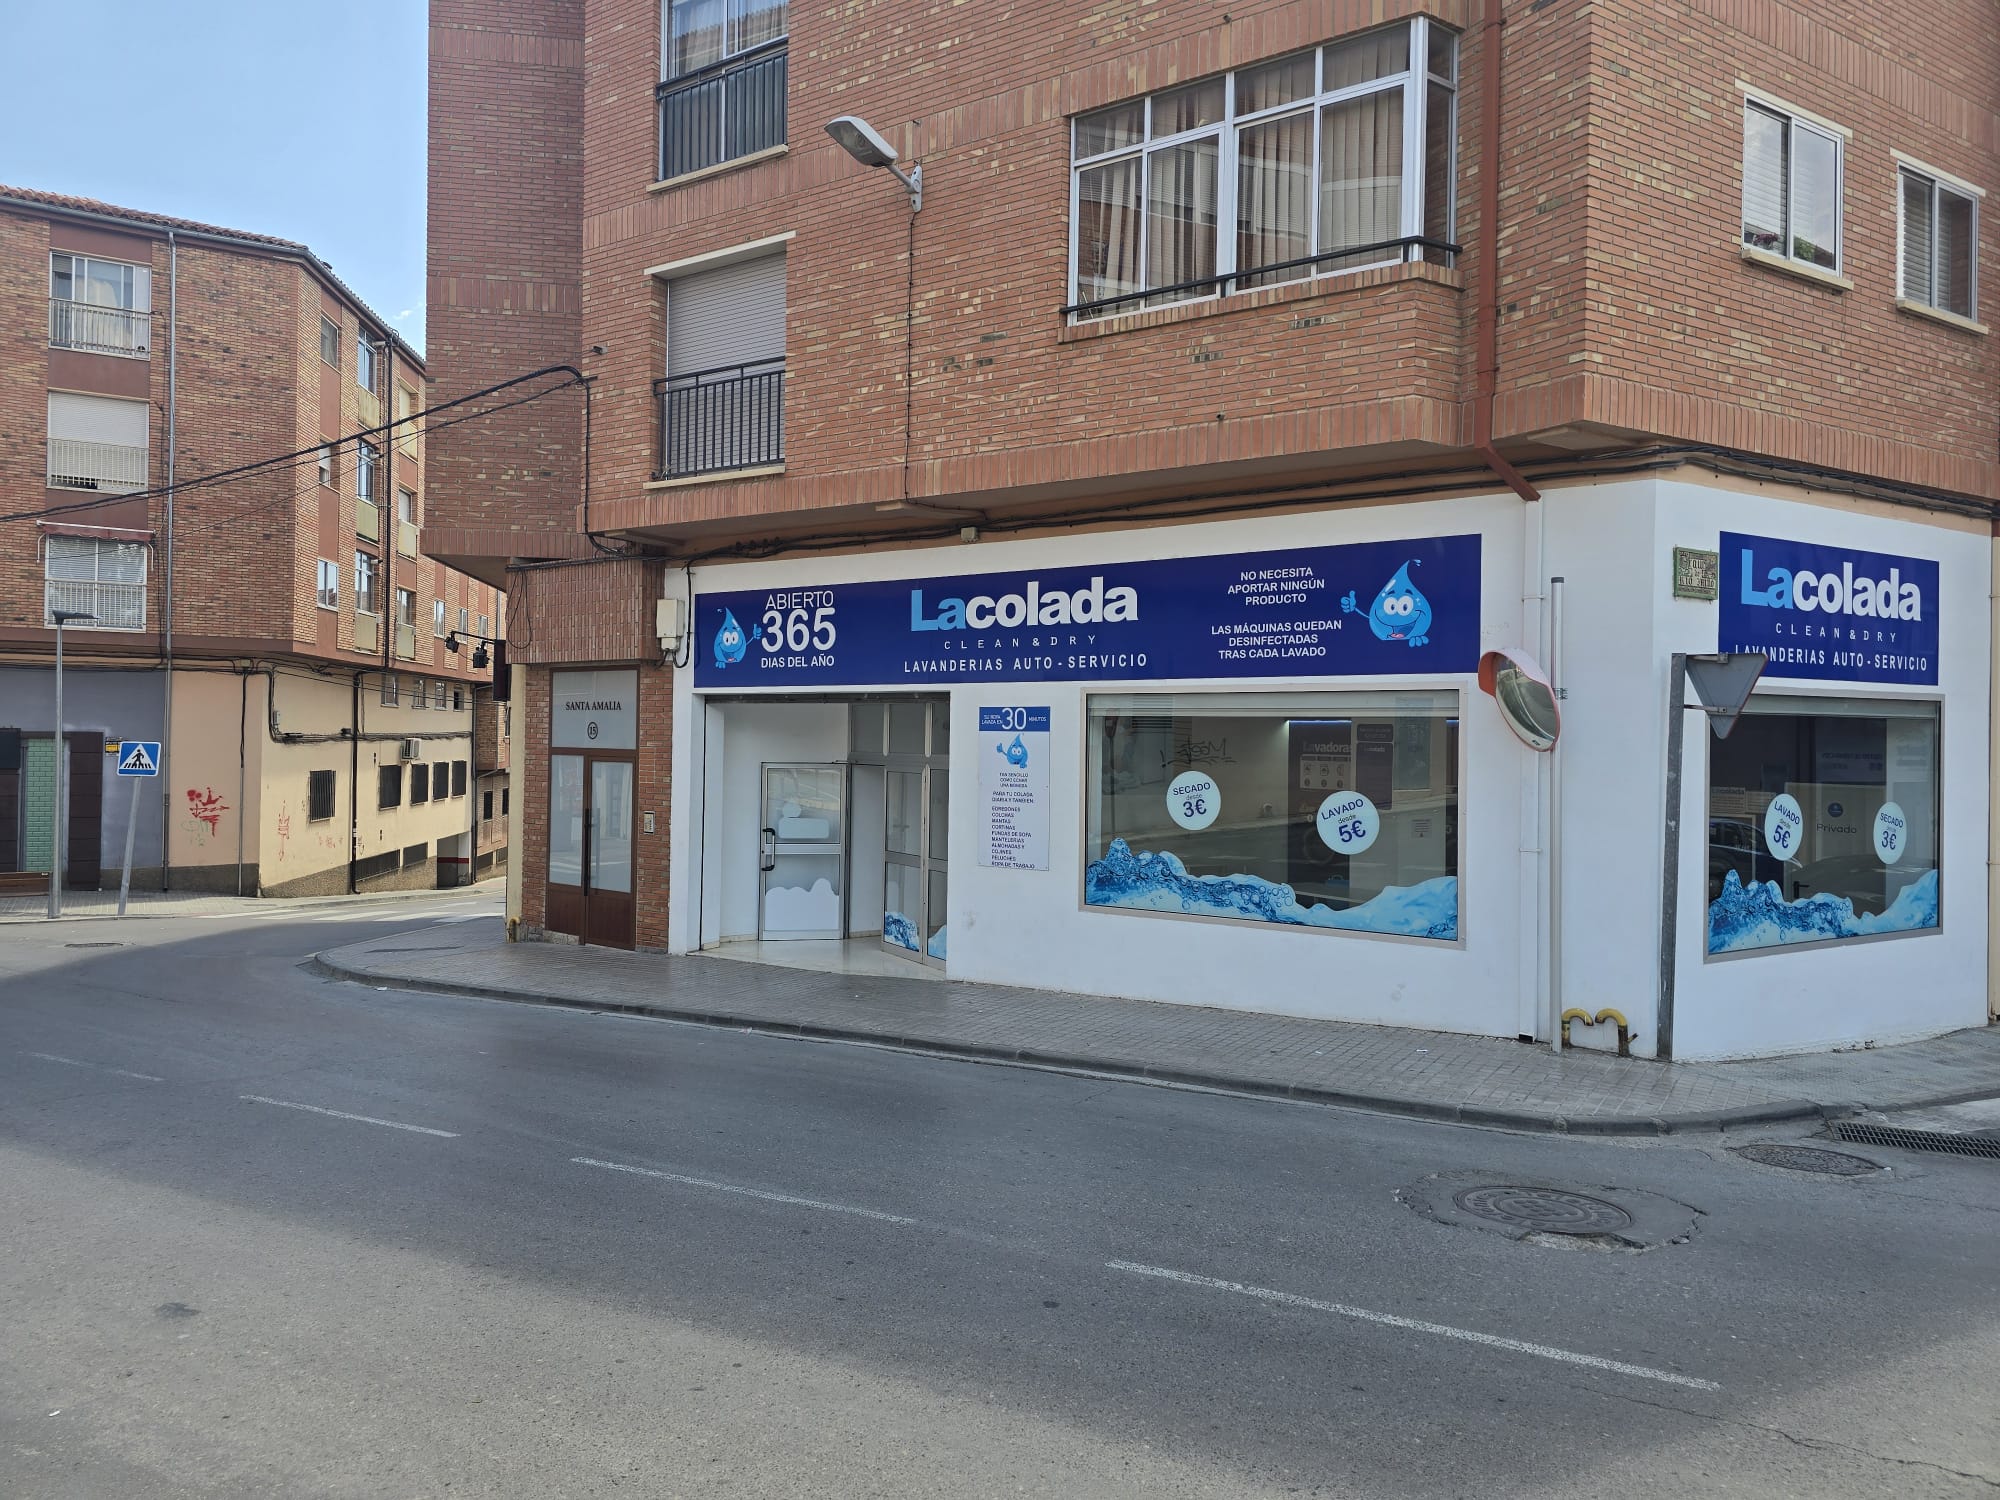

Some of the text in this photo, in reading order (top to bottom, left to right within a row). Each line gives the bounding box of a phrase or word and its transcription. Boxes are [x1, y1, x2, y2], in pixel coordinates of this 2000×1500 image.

[1240, 567, 1313, 581] NO NECESITA
[1228, 578, 1325, 594] APORTAR NINGÚN
[1741, 549, 1921, 621] Lacolada
[765, 591, 834, 610] ABIERTO
[911, 577, 1138, 631] Lacolada
[1245, 593, 1307, 606] PRODUCTO
[761, 608, 836, 653] 365
[1211, 619, 1342, 635] LAS MÁQUINAS QUEDAN
[1229, 634, 1318, 646] DESINFECTADAS
[761, 653, 835, 668] DIAS DEL AÑO
[1219, 646, 1326, 659] TRAS CADA LAVADO
[904, 657, 1003, 673] LAVANDERIAS
[565, 701, 621, 711] SANTA AMALIA
[1002, 708, 1026, 729] 30
[590, 726, 597, 735] 15
[1172, 782, 1211, 796] SECADO
[1183, 799, 1207, 818] 3€
[1321, 799, 1364, 820] LAVADO
[1774, 801, 1800, 825] LAVADO
[1880, 812, 1904, 828] SECADO
[1339, 820, 1366, 843] 5€
[1773, 824, 1791, 849] 5€
[1816, 823, 1857, 834] Privado
[1881, 830, 1897, 850] 3€
